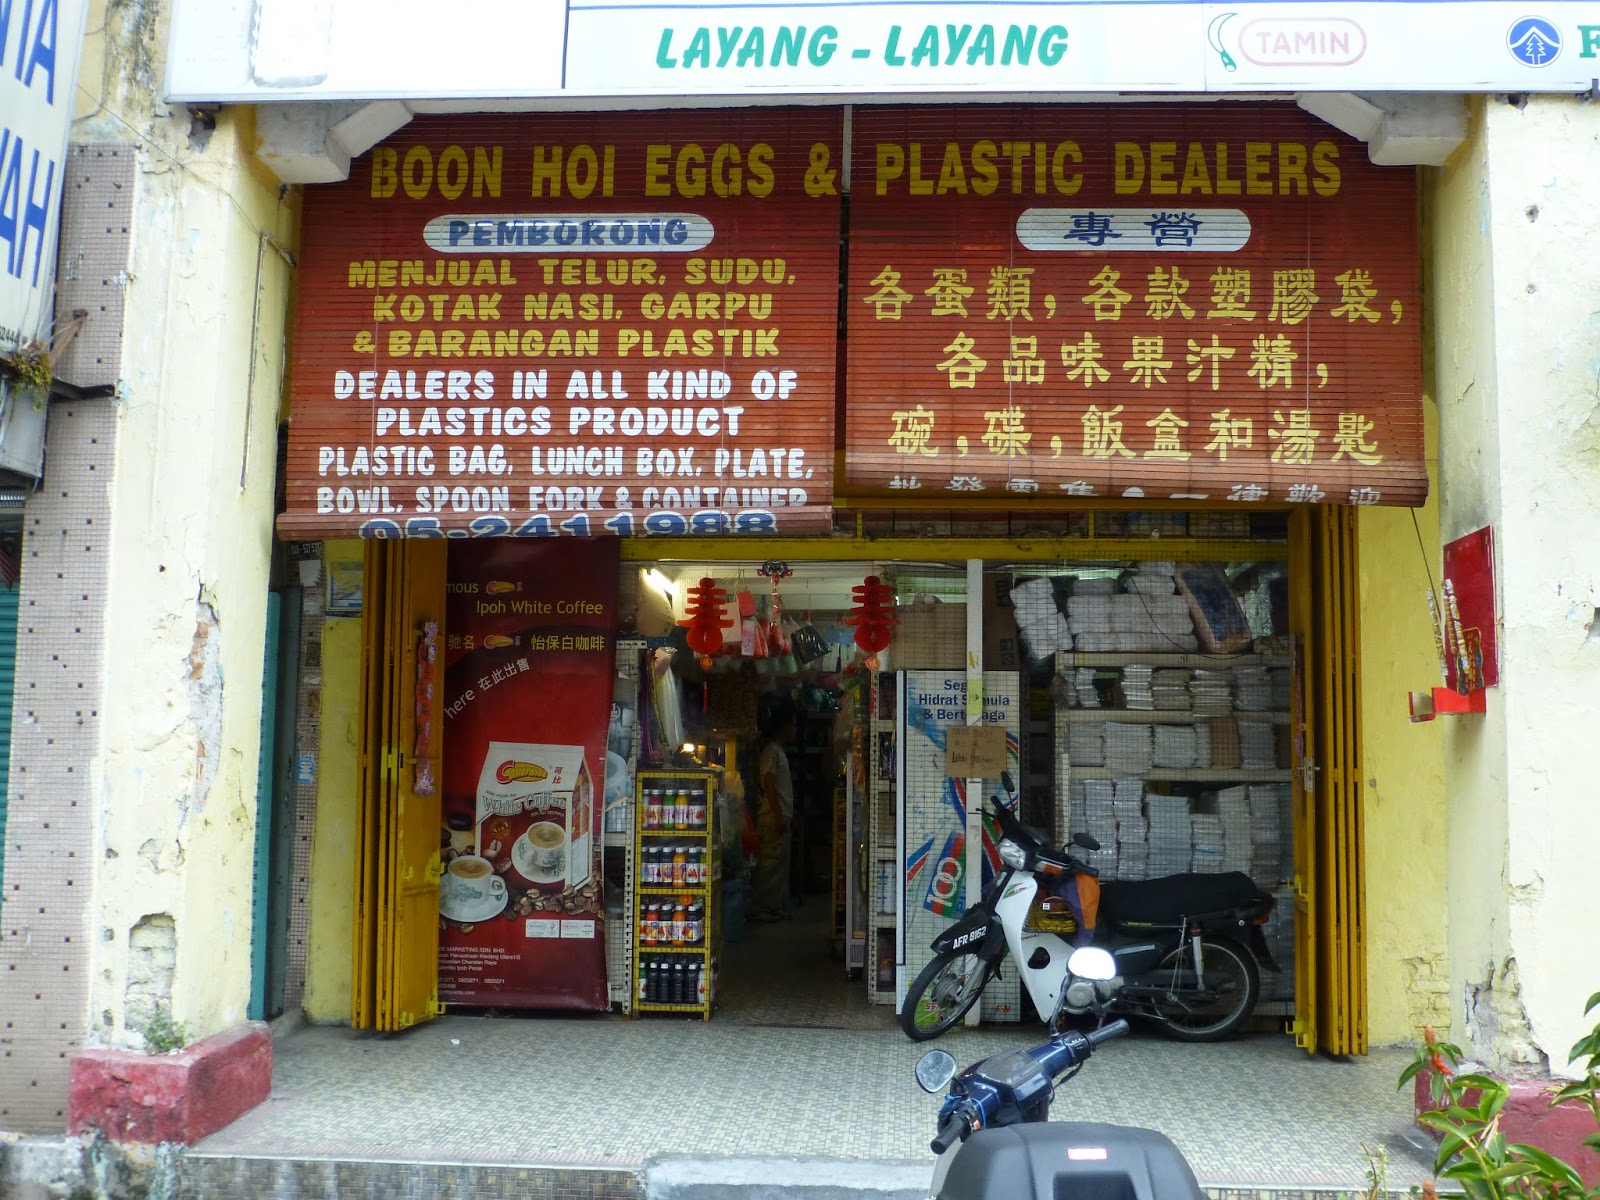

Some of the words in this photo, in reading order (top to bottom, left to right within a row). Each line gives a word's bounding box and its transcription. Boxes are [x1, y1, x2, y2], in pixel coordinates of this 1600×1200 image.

[656, 25, 838, 69] LAYANG
[884, 24, 1069, 68] LAYANG
[1256, 30, 1350, 55] TAMIN
[371, 145, 503, 200] BOON
[532, 145, 616, 199] HOI
[646, 144, 775, 198] EGGS
[804, 142, 838, 198] &
[876, 140, 1084, 197] PLASTIC
[1115, 140, 1342, 197] DEALERS
[449, 217, 688, 247] PEMBORONG
[1064, 211, 1204, 248] 專營
[349, 259, 517, 289] MENJUAL
[686, 258, 797, 287] SUDU,
[372, 293, 503, 323] KOTAK
[641, 292, 773, 321] GARPU
[352, 329, 375, 354] &
[388, 328, 599, 358] BARANGAN
[618, 327, 780, 358] PLASTIK
[335, 370, 495, 401] DEALERS
[512, 369, 548, 400] IN
[565, 370, 630, 400] ALL
[647, 369, 733, 401] KIND
[752, 370, 798, 400] OF
[376, 405, 552, 437] PLASTICS
[569, 404, 744, 436] PRODUCT
[318, 445, 436, 477] PLASTIC
[449, 444, 514, 477] BAG,
[532, 445, 623, 477] LUNCH
[715, 447, 815, 479] PLATE,
[316, 486, 403, 515] BOWL,
[529, 486, 604, 512] FORK
[615, 486, 633, 510] &
[477, 600, 506, 616] Ipoh
[511, 600, 551, 614] White
[556, 600, 603, 614] Coffee
[531, 635, 605, 651] 怡保白咖啡
[478, 658, 530, 691] 在此出售
[444, 689, 476, 719] here
[918, 693, 958, 705] Hidrat
[924, 708, 933, 720] &
[482, 795, 523, 816] White
[524, 790, 567, 812] Coffee
[953, 934, 968, 949] AFR
[969, 926, 988, 945] 8162
